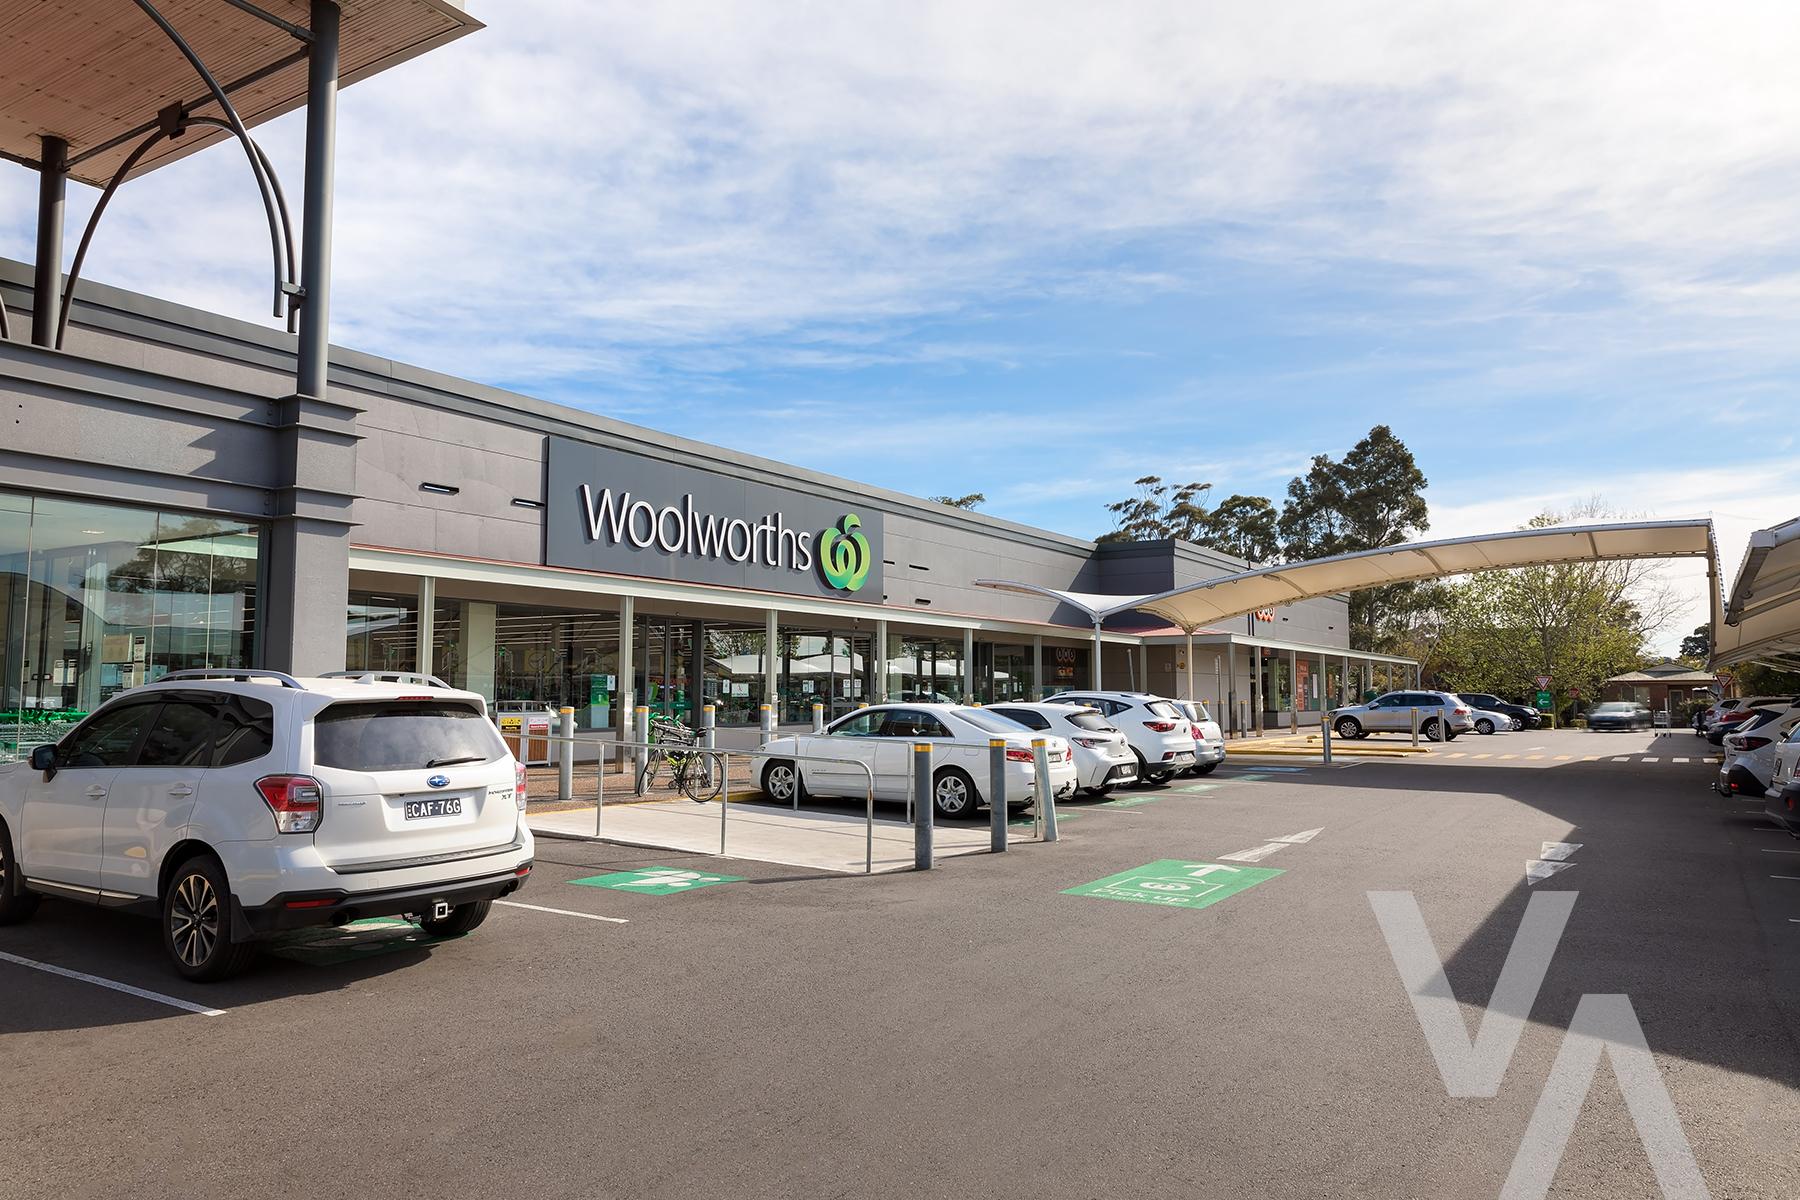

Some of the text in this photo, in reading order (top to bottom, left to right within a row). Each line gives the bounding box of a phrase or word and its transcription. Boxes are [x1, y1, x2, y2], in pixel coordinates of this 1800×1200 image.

[581, 484, 812, 571] Woolworths
[1092, 888, 1147, 898] Pick
[1153, 895, 1190, 903] up
